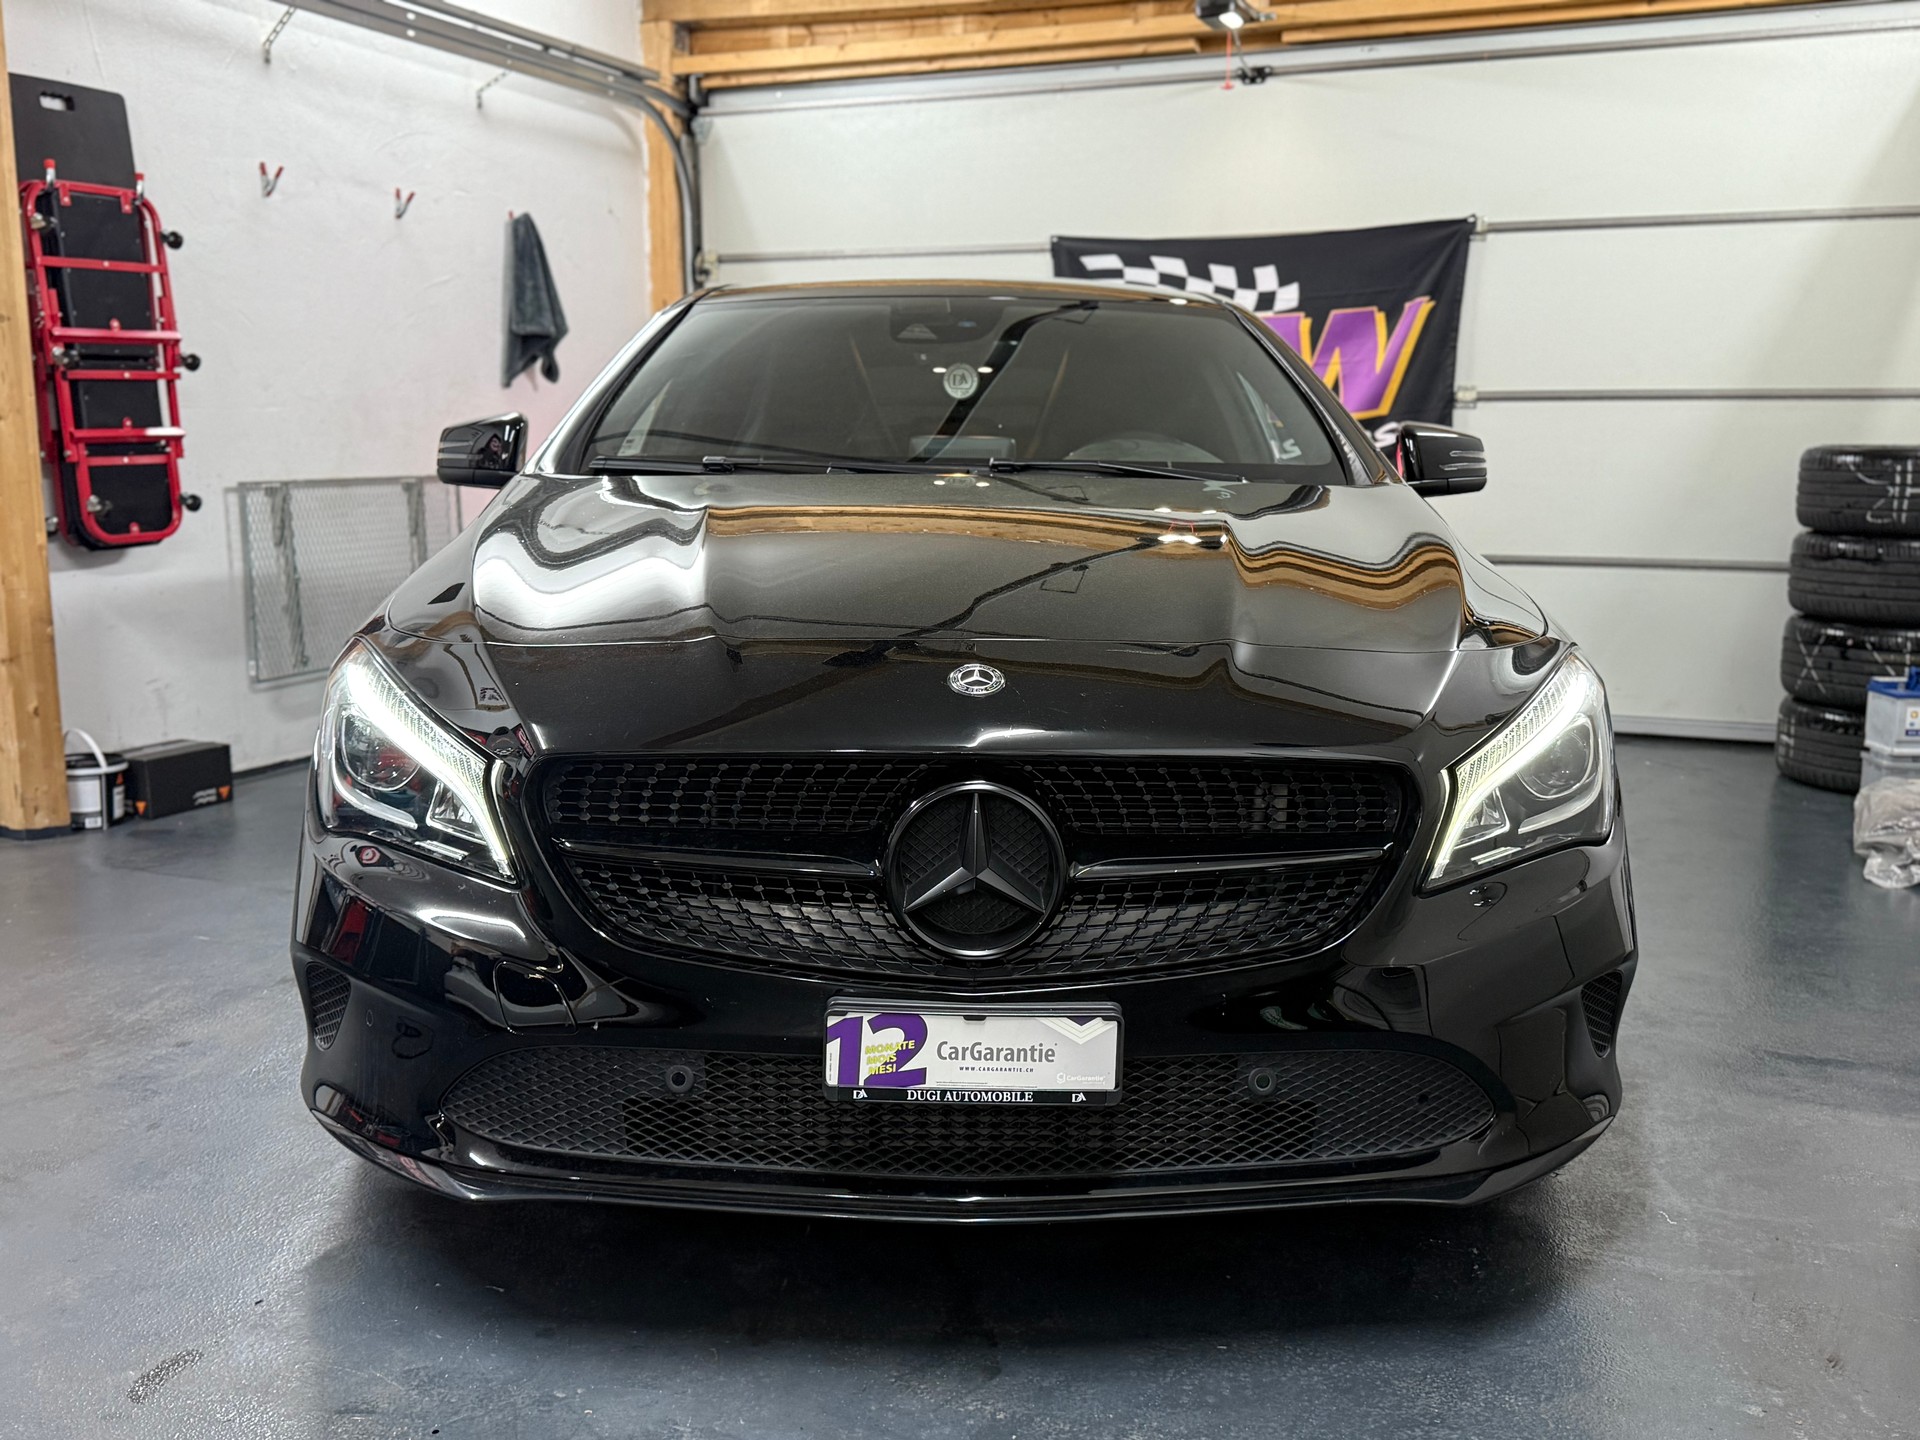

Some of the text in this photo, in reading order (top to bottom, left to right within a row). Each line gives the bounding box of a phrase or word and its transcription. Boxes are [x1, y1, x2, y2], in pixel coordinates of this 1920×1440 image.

[827, 1012, 928, 1088] 12
[864, 1040, 916, 1055] MONATE
[936, 1041, 1056, 1063] CarGarantie
[866, 1053, 897, 1066] MOIS
[868, 1063, 897, 1075] MESI
[959, 1065, 1034, 1073] WWW.CARGARANTIE.CH
[907, 1089, 1034, 1102] DUGI AUTOMOBILE
